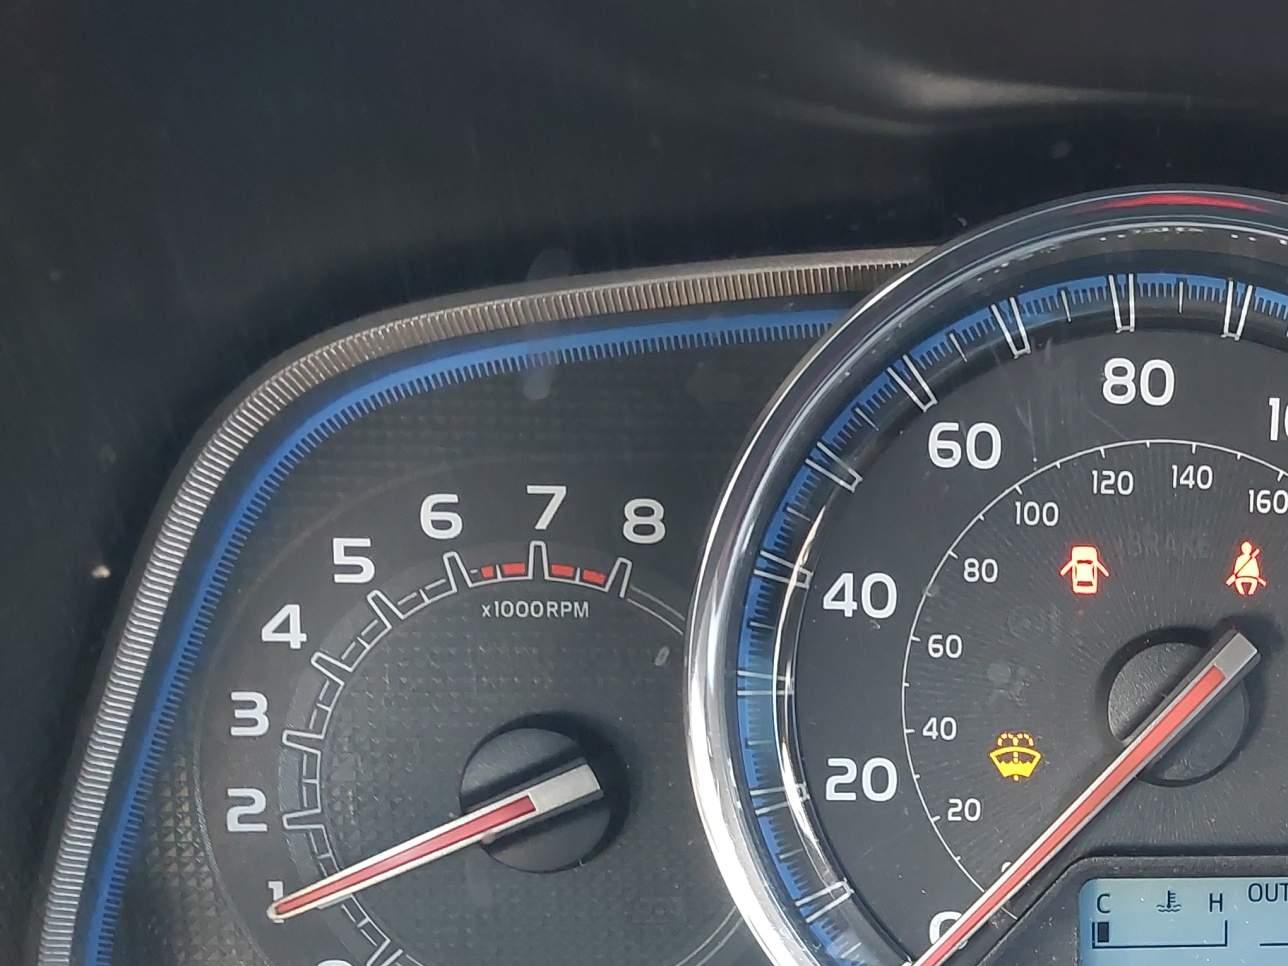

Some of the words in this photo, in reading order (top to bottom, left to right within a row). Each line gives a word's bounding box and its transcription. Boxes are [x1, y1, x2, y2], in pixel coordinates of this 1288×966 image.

[1102, 357, 1175, 406] 80
[928, 422, 1002, 470] 60
[1091, 470, 1134, 495] 120
[1171, 464, 1213, 490] 140
[420, 493, 463, 540] 6
[526, 485, 567, 530] 7
[1015, 501, 1059, 527] 100
[1248, 489, 1288, 514] 160
[622, 498, 666, 544] 8
[332, 537, 375, 584] 5
[963, 557, 998, 583] 80
[481, 600, 589, 618] x1000RPM
[823, 572, 897, 619] 40
[261, 604, 307, 649] 4
[927, 634, 963, 659] 60
[230, 691, 270, 736] 3
[922, 716, 957, 741] 40
[825, 757, 898, 802] 20
[226, 788, 268, 832] 2
[947, 798, 981, 822] 20
[1096, 893, 1111, 914] C
[1209, 892, 1223, 913] H
